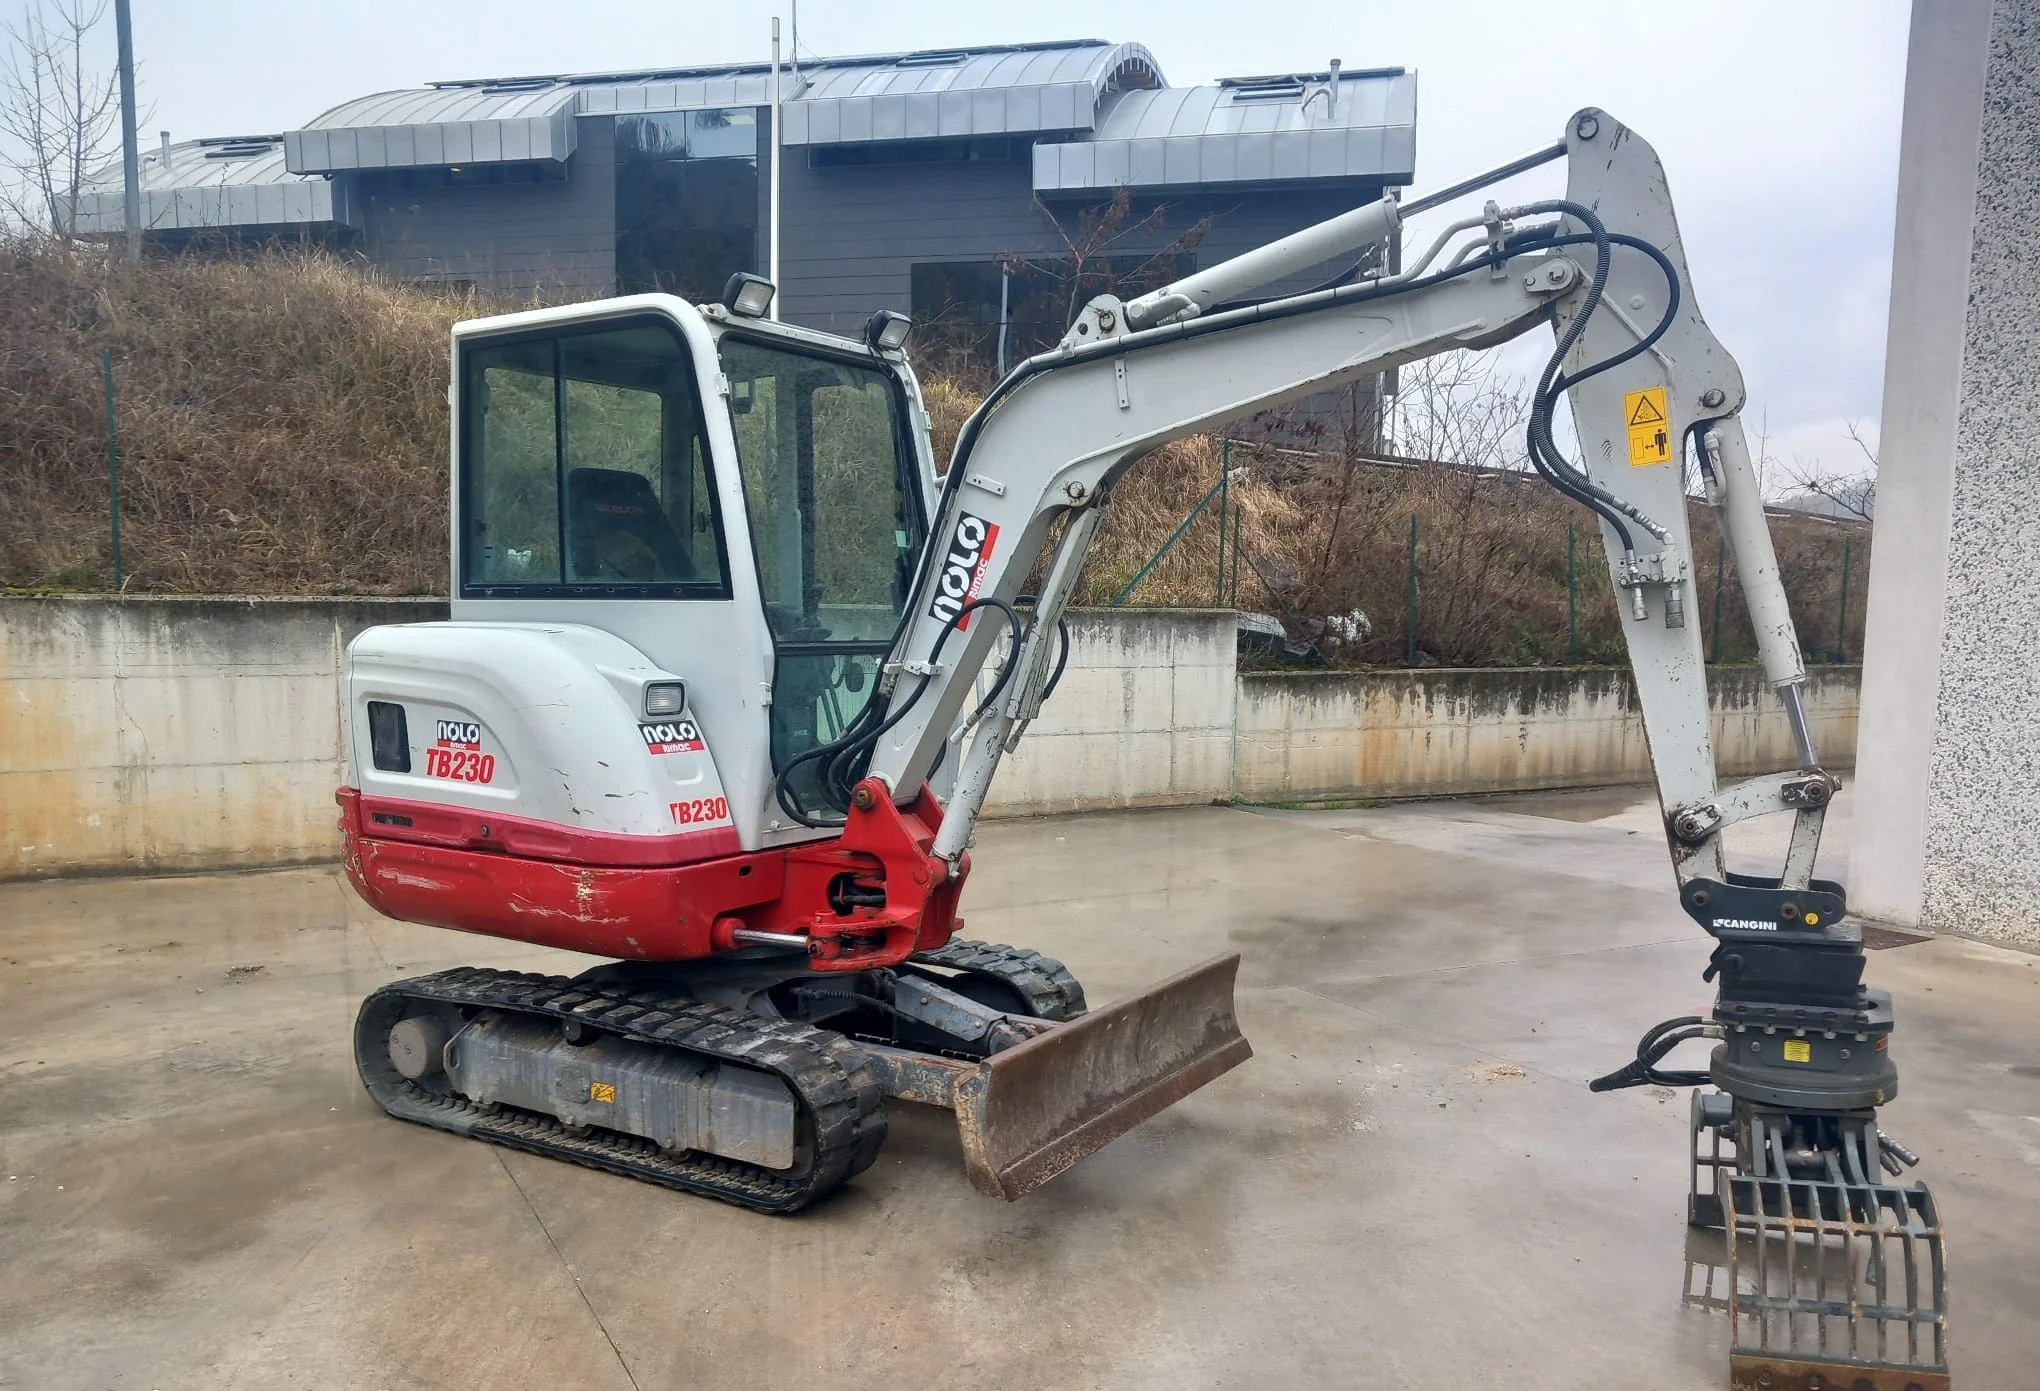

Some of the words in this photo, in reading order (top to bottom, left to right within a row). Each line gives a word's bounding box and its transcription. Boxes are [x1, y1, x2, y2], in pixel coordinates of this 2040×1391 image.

[426, 748, 495, 784] TB230
[669, 797, 727, 824] TB230
[1723, 919, 1777, 931] CANGINI
